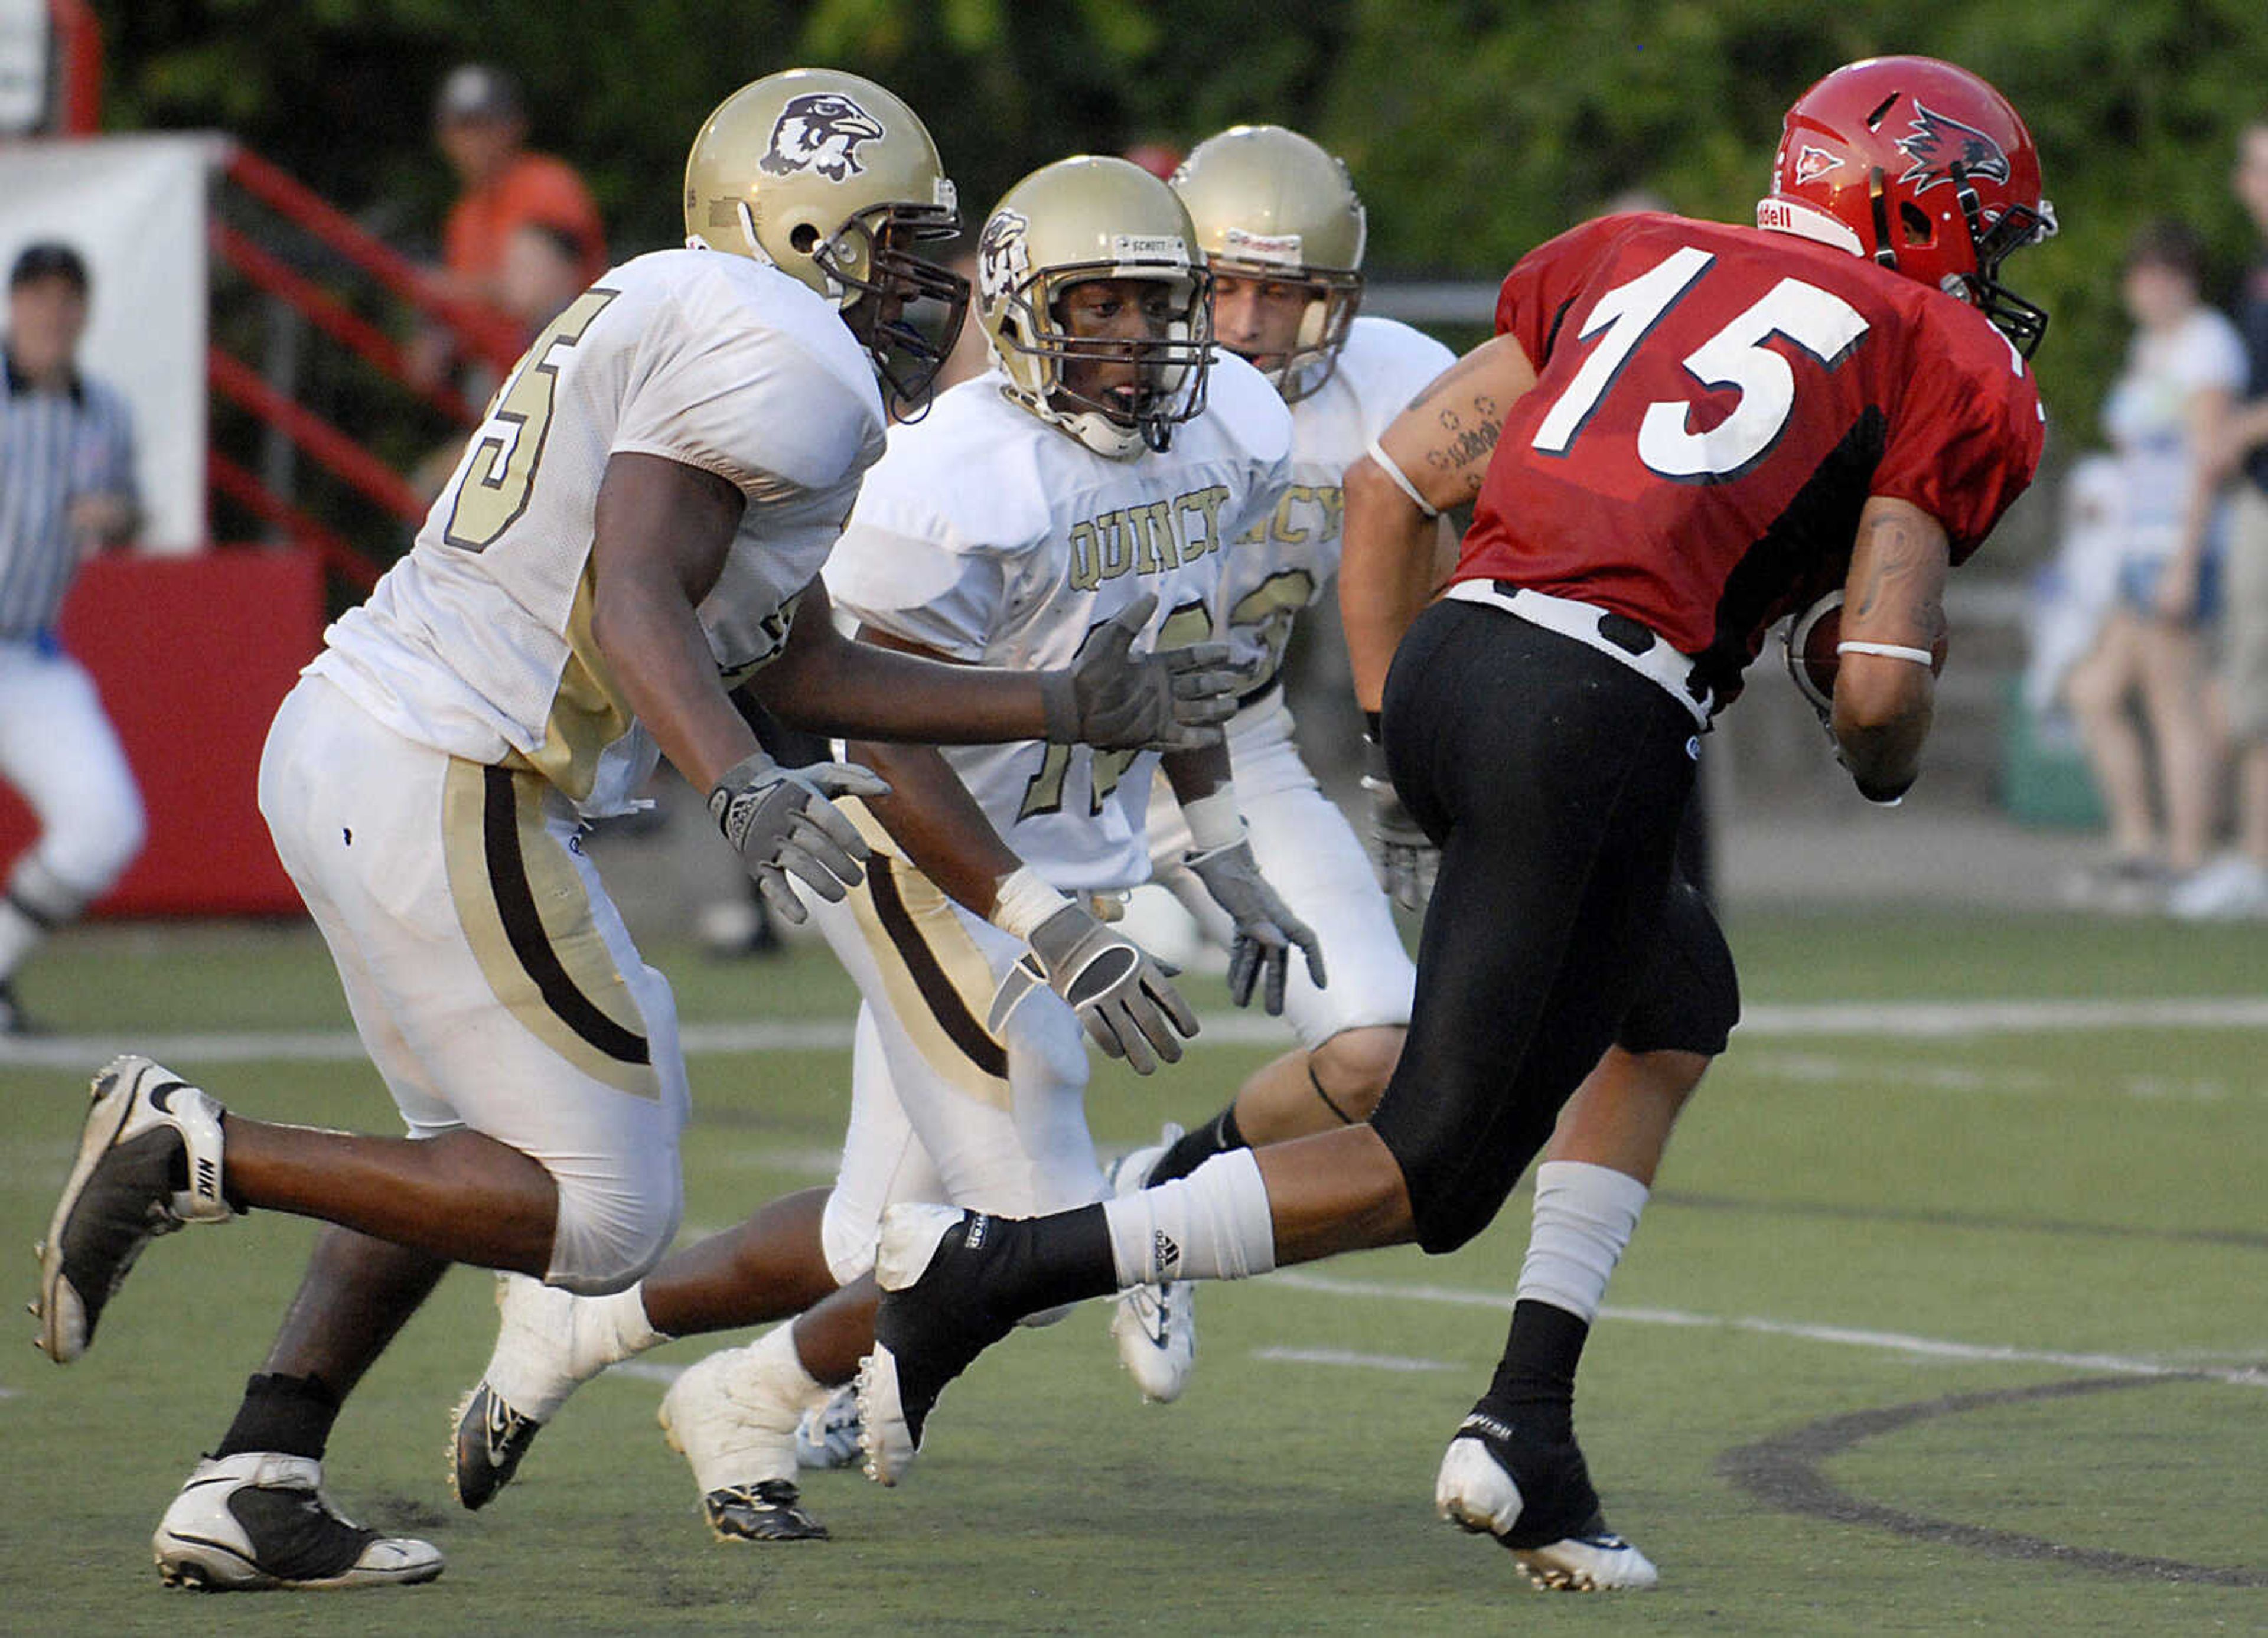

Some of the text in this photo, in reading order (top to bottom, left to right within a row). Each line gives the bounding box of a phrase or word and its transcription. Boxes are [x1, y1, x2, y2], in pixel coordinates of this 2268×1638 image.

[1531, 246, 1871, 485] 15
[1068, 485, 1230, 592] QUINCY
[198, 1157, 216, 1201] NIKE
